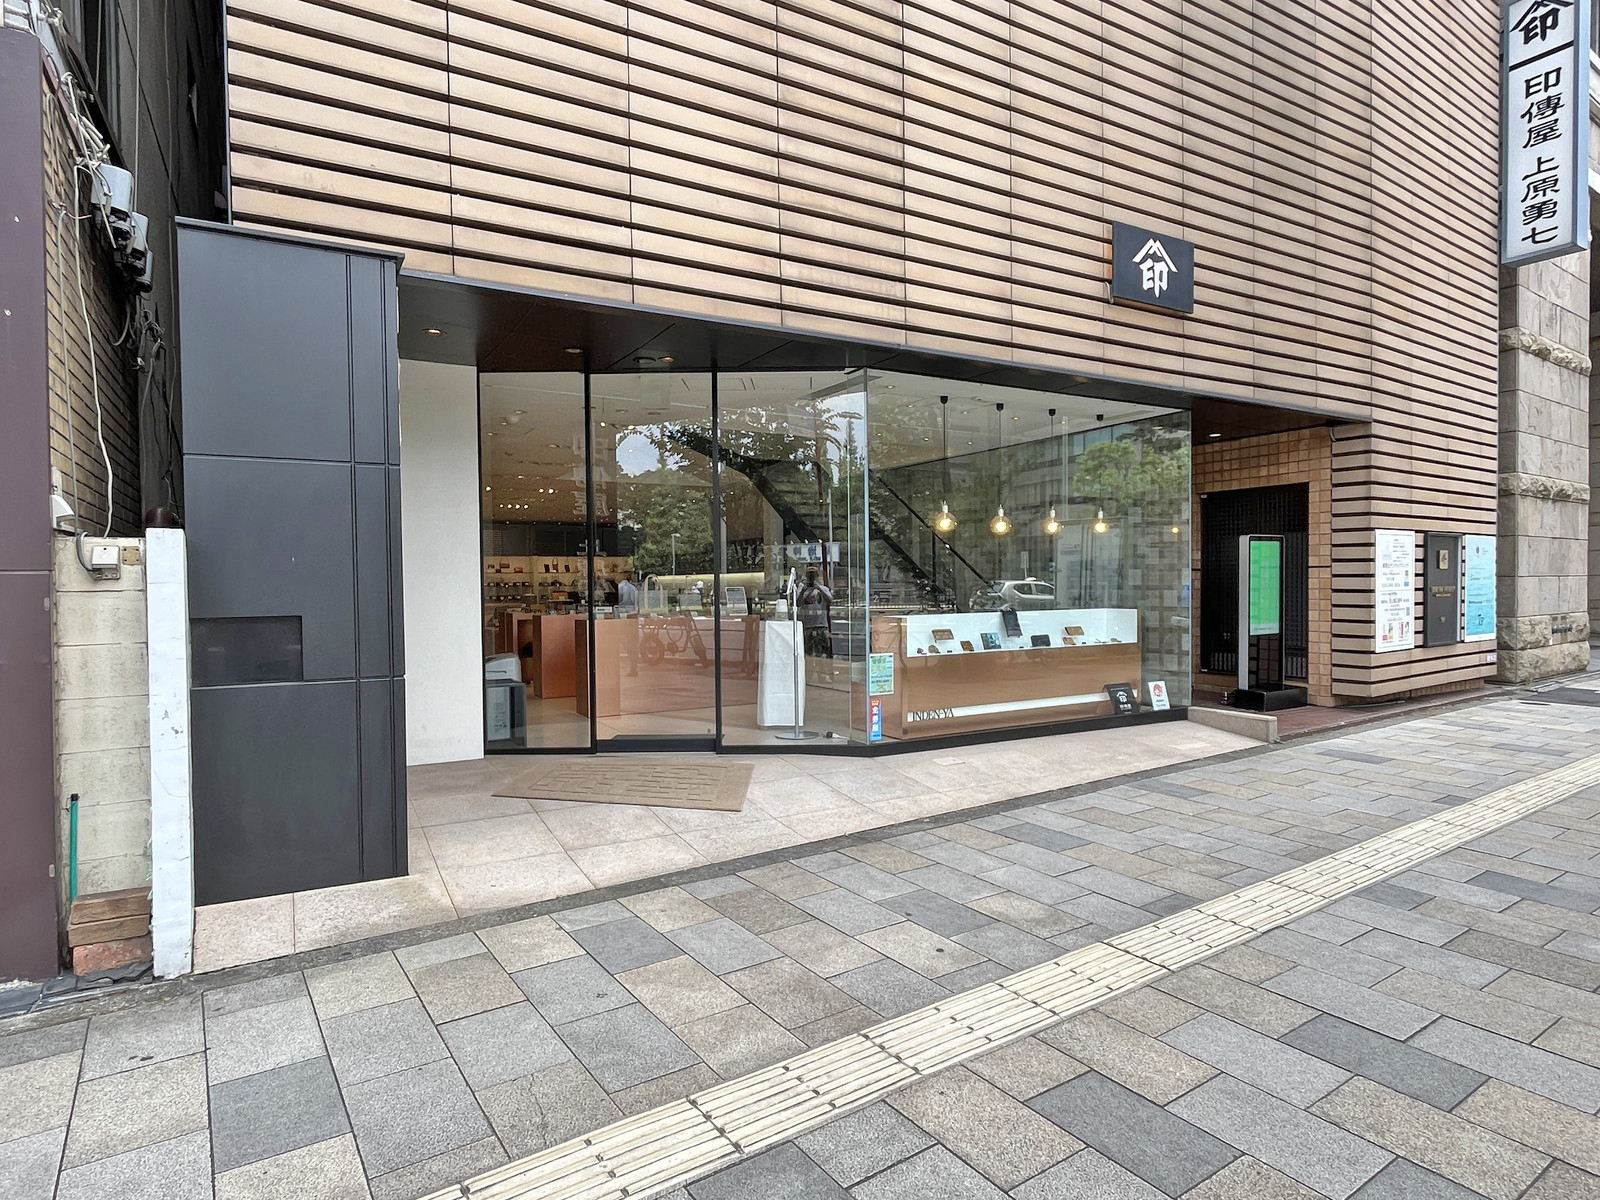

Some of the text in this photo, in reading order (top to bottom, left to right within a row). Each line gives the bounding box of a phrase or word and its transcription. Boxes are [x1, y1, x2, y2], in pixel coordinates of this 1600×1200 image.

[1520, 66, 1566, 246] 印傳屋 上原勇七
